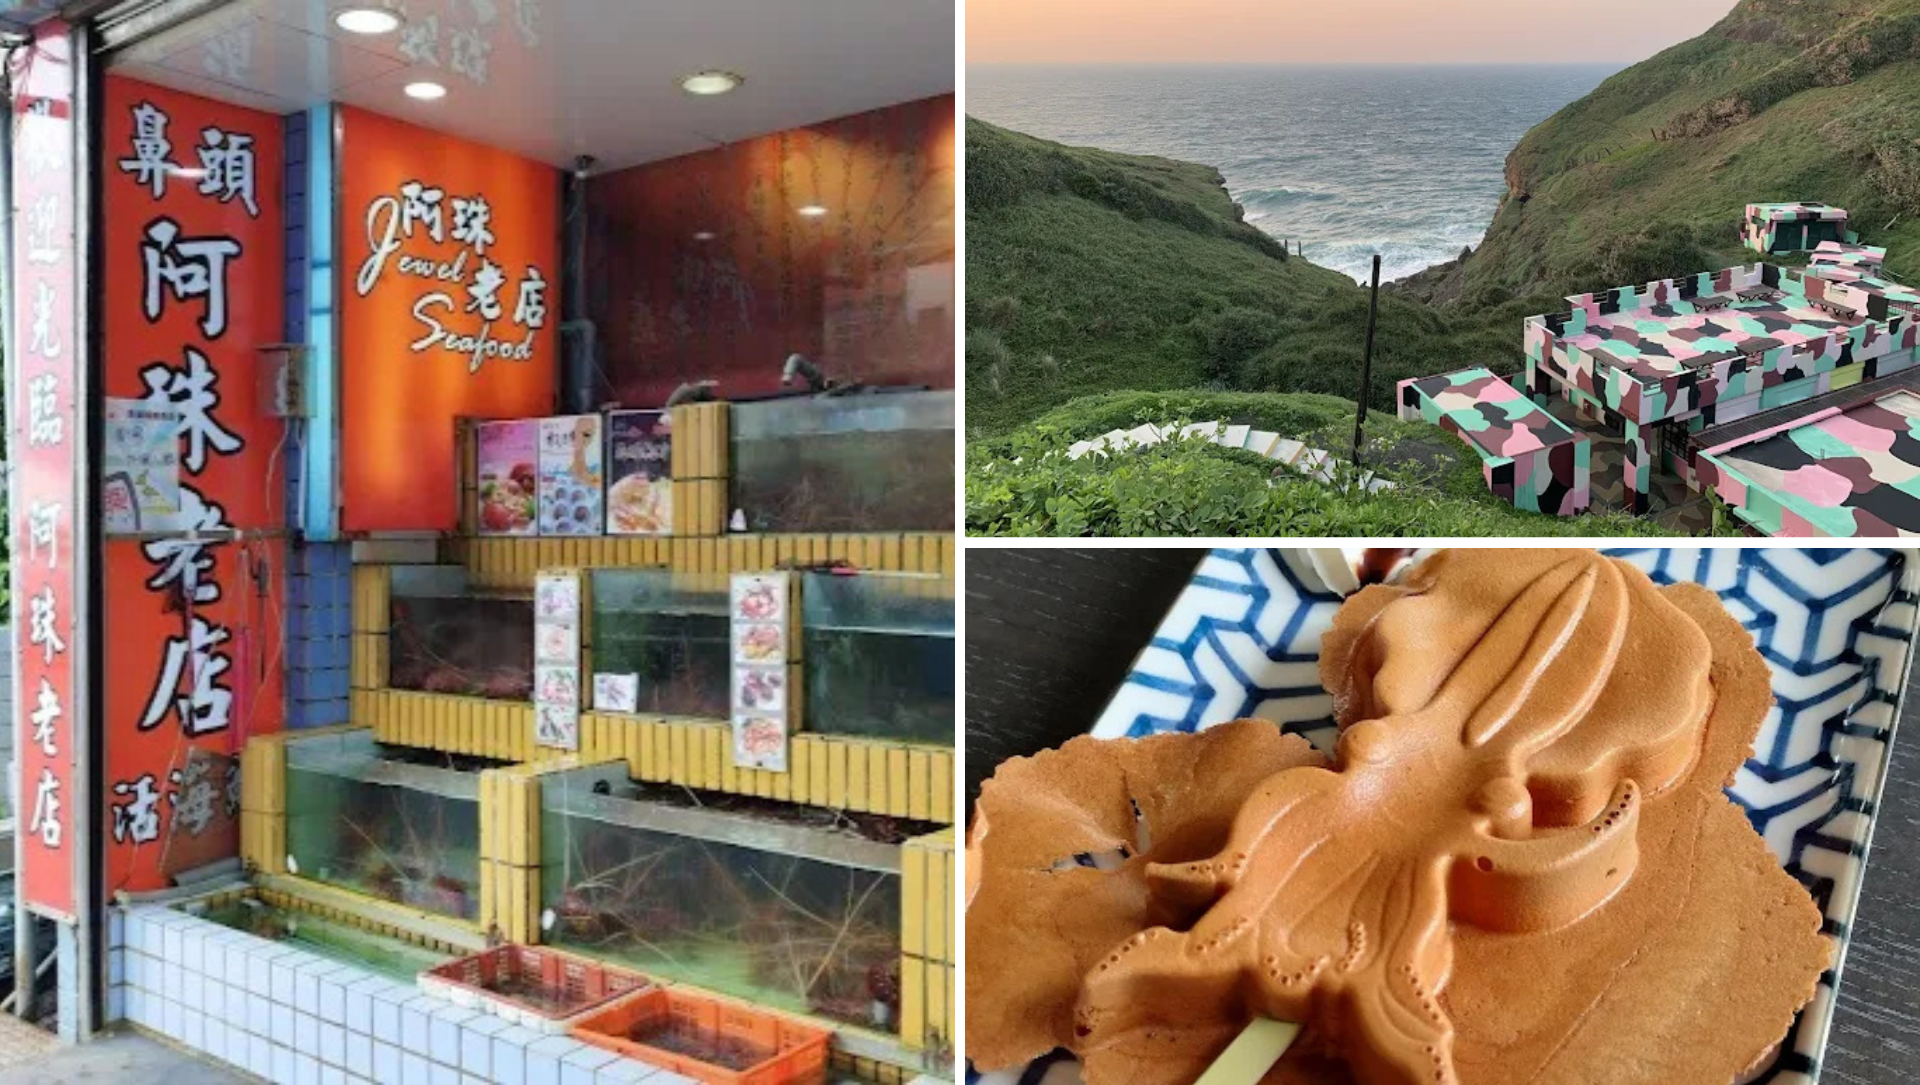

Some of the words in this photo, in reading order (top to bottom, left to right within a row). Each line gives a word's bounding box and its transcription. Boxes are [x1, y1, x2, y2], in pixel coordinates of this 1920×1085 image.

[118, 101, 260, 218] 鼻頭
[357, 196, 468, 296] Jewel
[399, 179, 496, 256] 阿珠
[410, 291, 533, 373] Seafood
[464, 254, 547, 330] 老店
[139, 218, 242, 736] 阿珠老店
[30, 503, 64, 846] 阿珠老店
